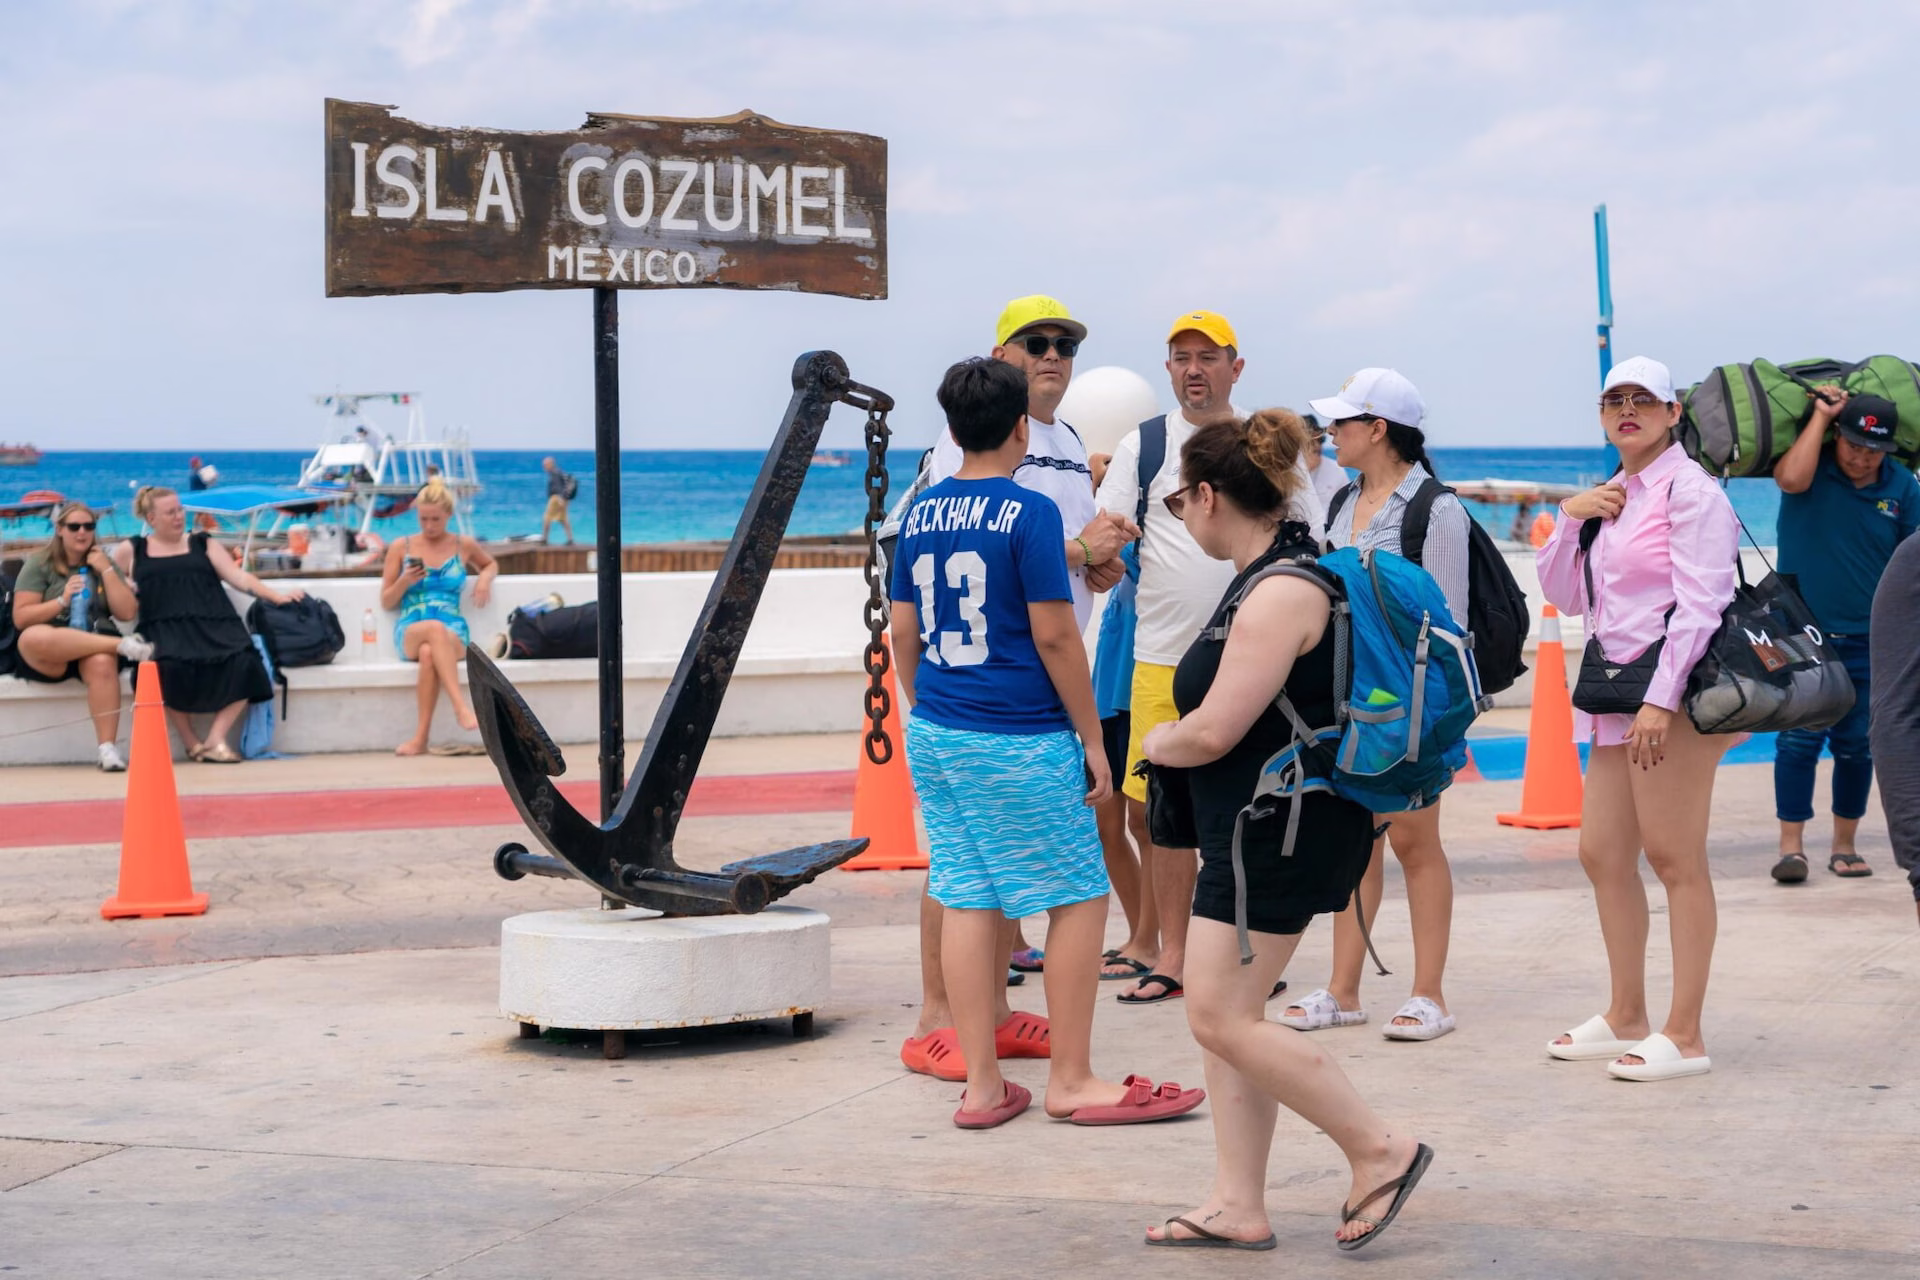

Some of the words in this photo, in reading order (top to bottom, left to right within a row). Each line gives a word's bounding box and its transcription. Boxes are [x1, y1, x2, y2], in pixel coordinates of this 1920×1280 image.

[350, 142, 516, 224] ISLA
[567, 156, 872, 238] COZUMEL
[548, 246, 698, 283] MEXICO
[905, 496, 990, 538] BECKHAM
[987, 499, 1022, 534] JR
[912, 551, 989, 667] 13
